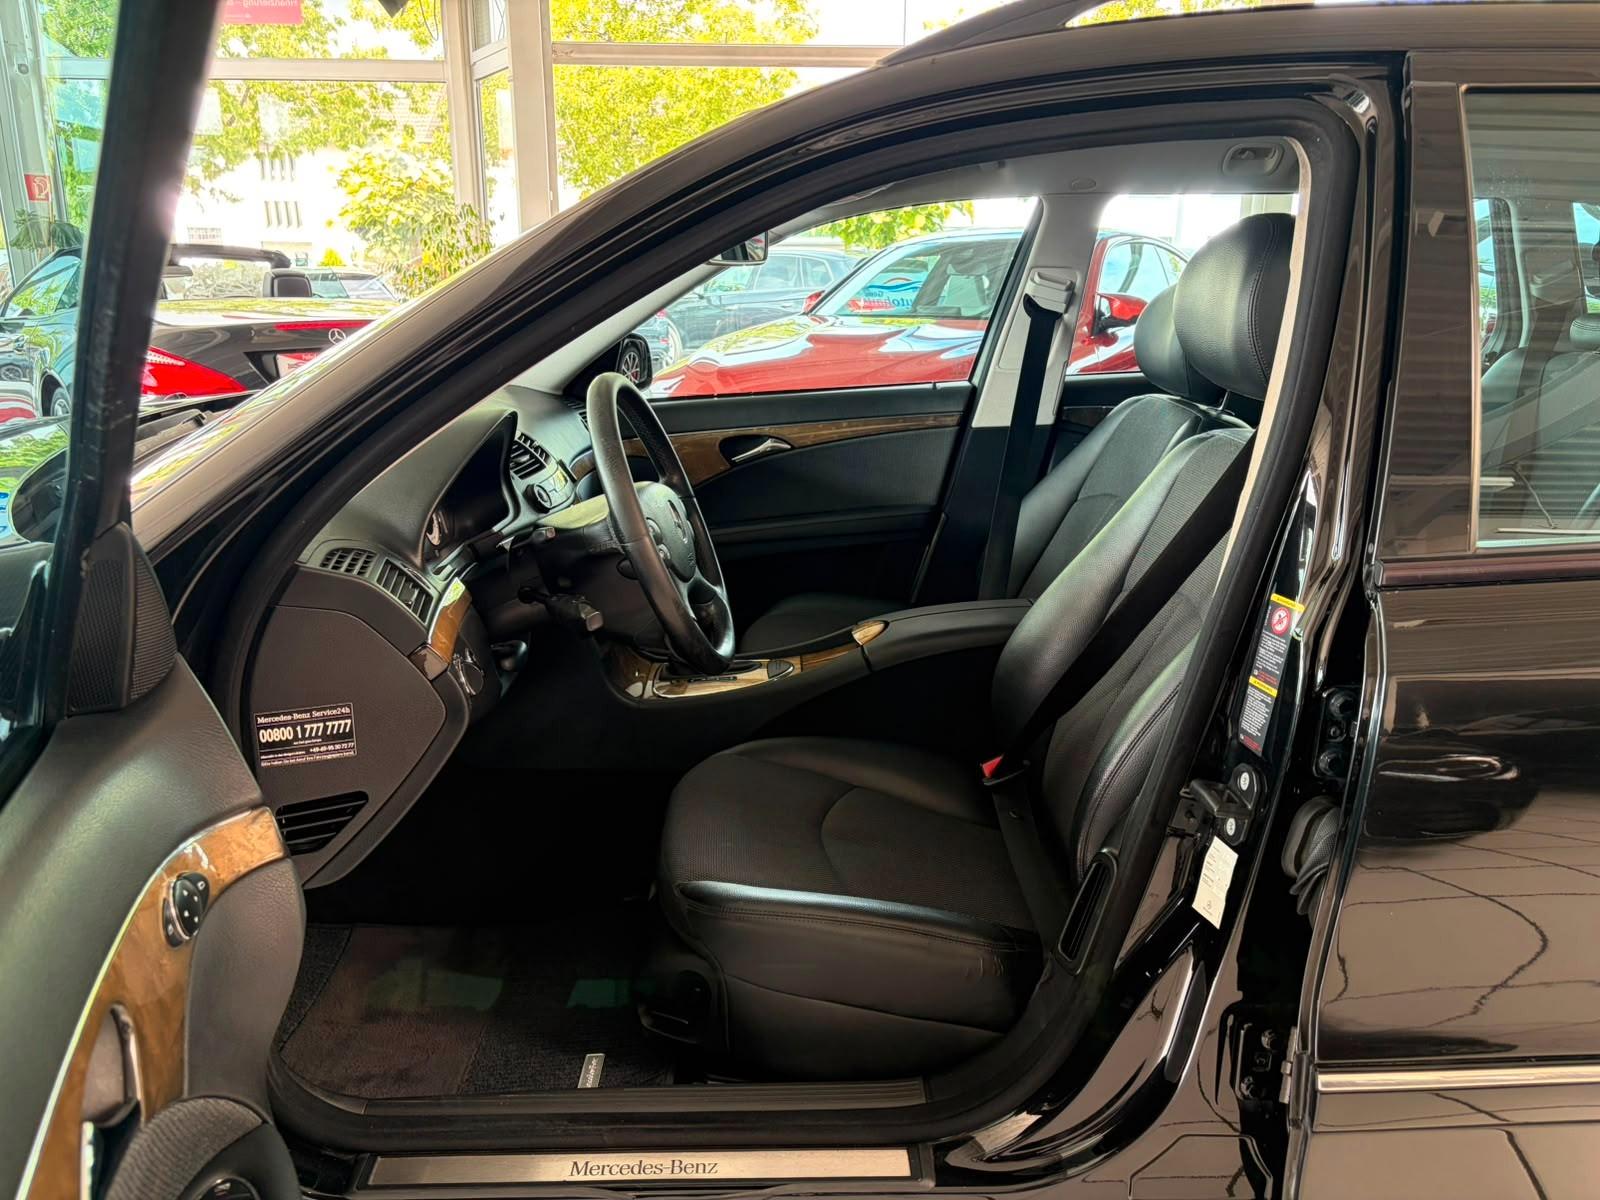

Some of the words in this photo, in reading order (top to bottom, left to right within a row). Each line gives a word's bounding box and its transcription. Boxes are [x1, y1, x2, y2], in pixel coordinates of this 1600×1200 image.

[257, 713, 310, 724] Mercedes-Benz
[312, 707, 350, 717] Service24h
[259, 726, 294, 743] 00800
[296, 725, 302, 739] 1
[304, 722, 324, 738] 777
[325, 719, 352, 735] 7777
[569, 1159, 719, 1176] Mercedes-Benz
